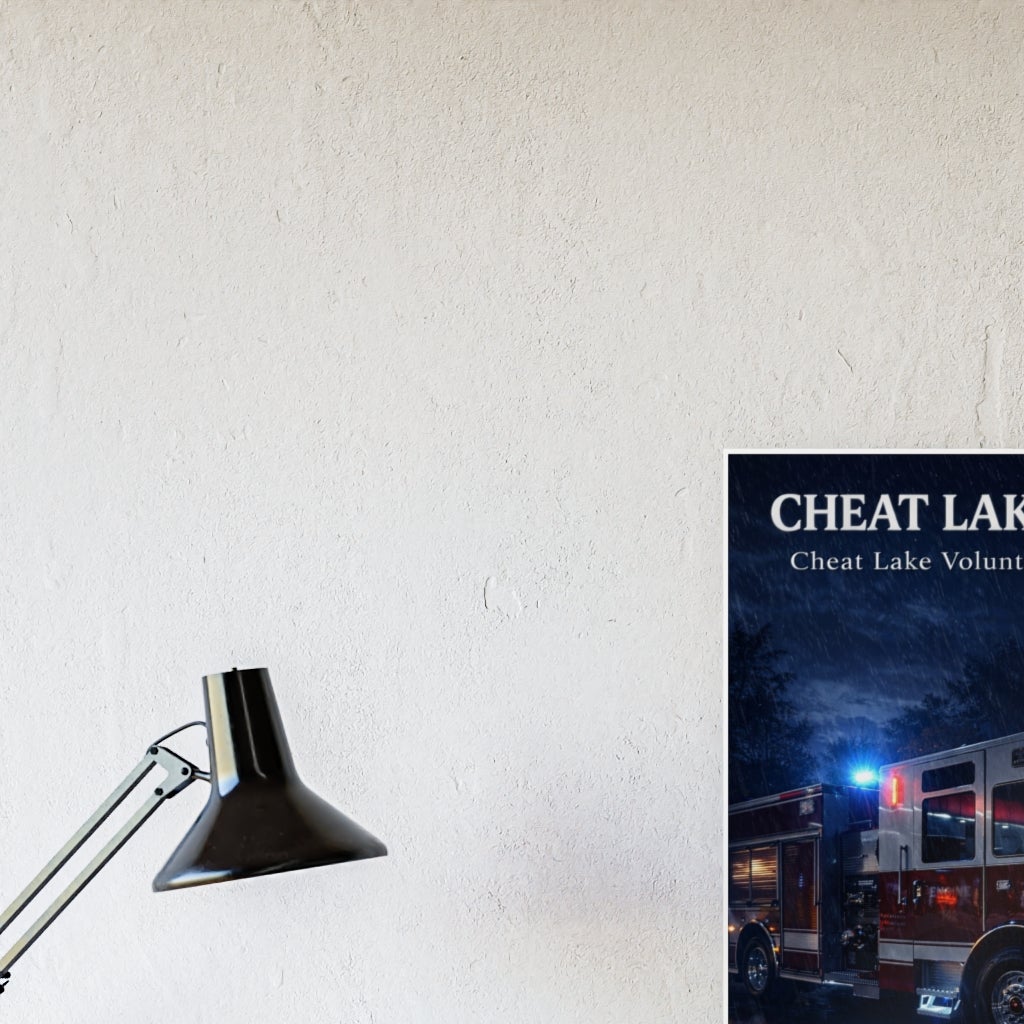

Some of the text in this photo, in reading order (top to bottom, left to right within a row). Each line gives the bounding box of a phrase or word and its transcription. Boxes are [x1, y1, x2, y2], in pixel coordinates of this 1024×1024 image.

[770, 493, 929, 532] CHEAT
[790, 550, 863, 571] Cheat
[874, 550, 932, 571] Lake
